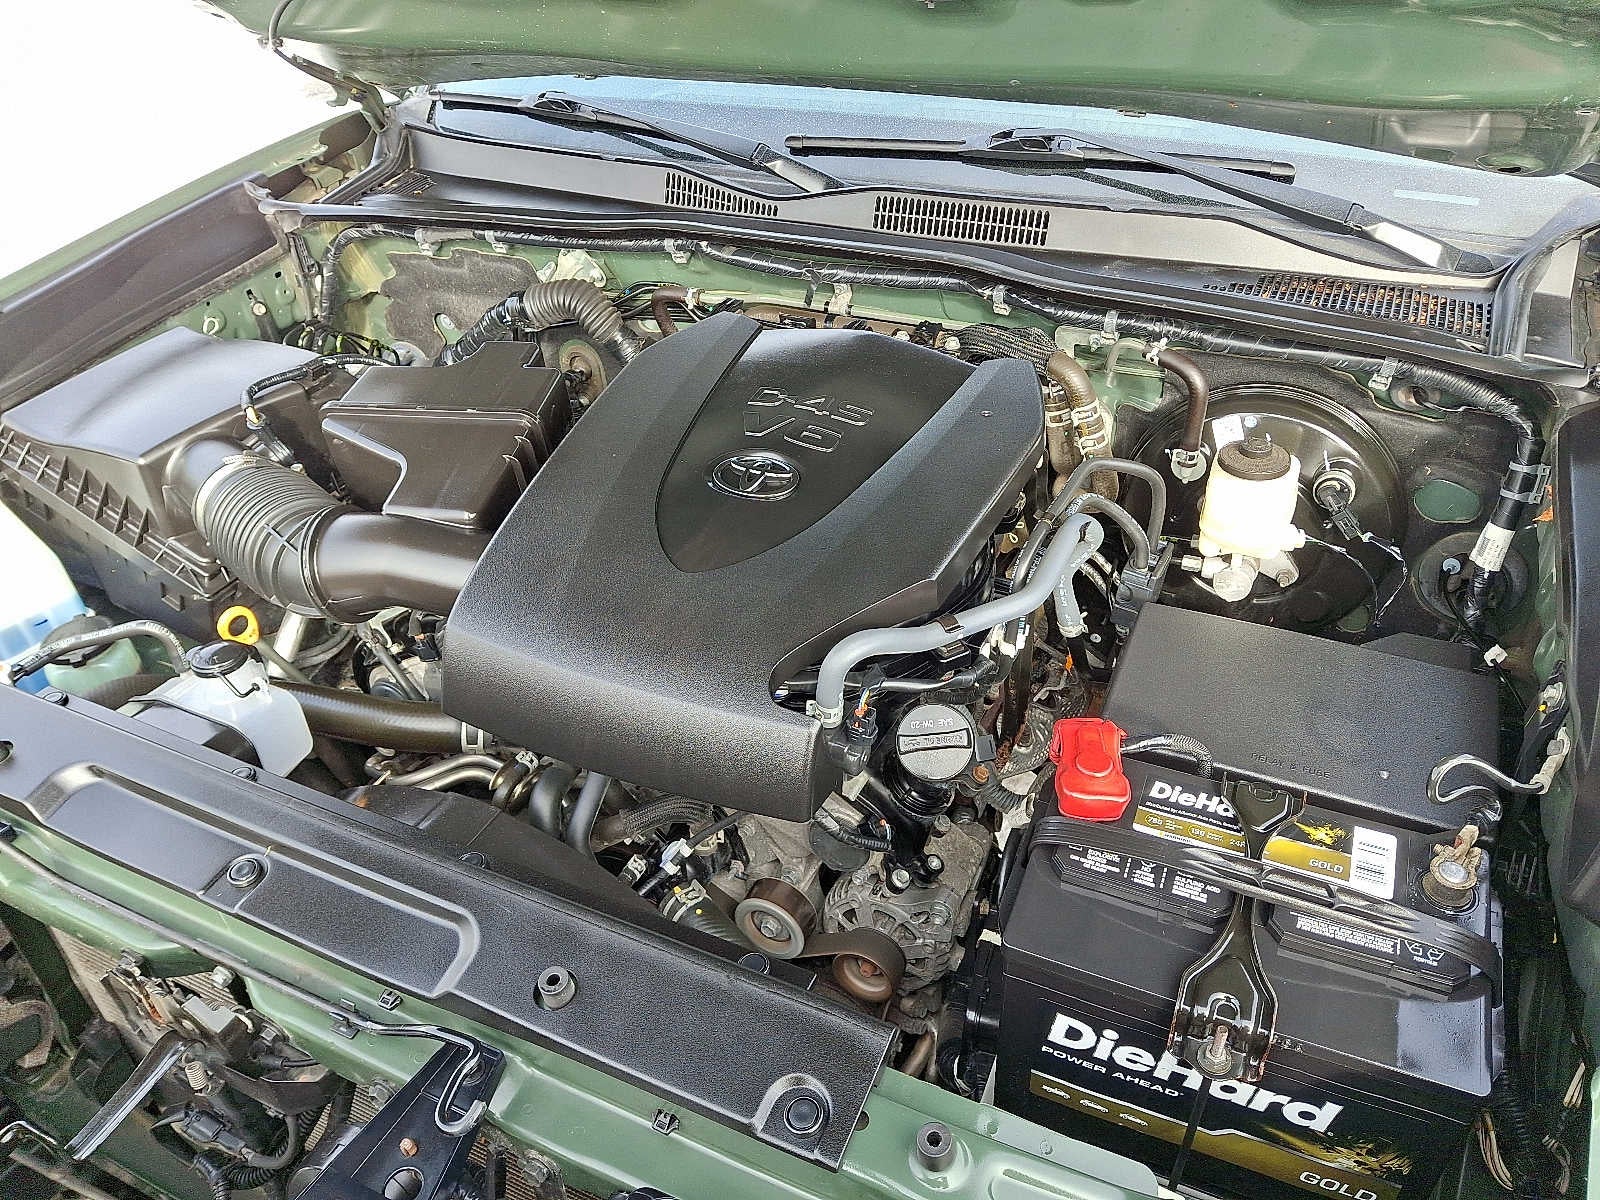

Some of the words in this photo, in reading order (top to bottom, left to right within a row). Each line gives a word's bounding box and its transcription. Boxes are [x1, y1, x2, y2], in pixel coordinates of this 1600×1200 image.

[743, 411, 844, 453] V6
[1303, 765, 1331, 780] FUSE
[1148, 780, 1239, 818] DieHa
[1309, 859, 1344, 874] GOLD
[1041, 1045, 1107, 1074] POWER
[1112, 1071, 1181, 1097] AHEAD
[1047, 1012, 1344, 1133] DieHard
[1299, 1171, 1378, 1200] GOLD
